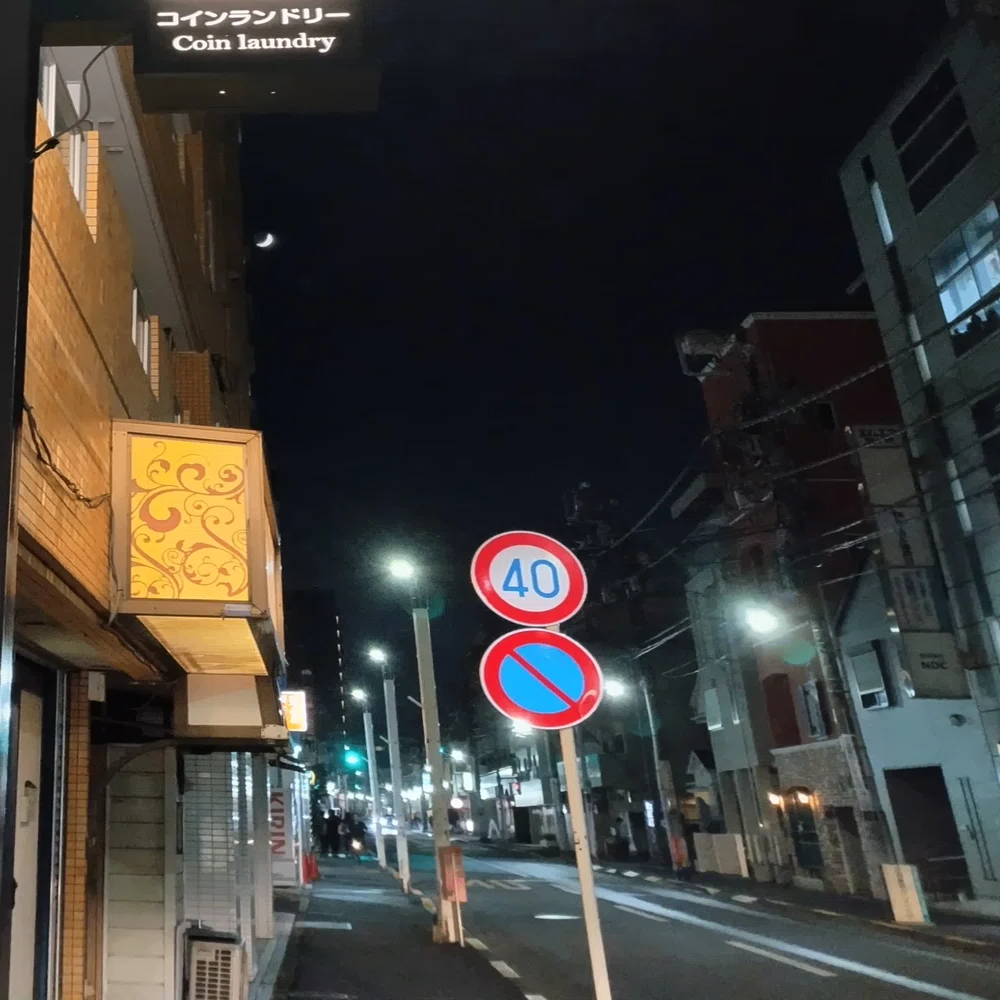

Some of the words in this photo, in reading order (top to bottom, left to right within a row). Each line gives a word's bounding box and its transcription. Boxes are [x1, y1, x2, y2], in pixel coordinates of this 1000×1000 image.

[156, 7, 351, 27] コインランドリー
[172, 34, 231, 51] Coin
[237, 32, 336, 53] laundry
[502, 558, 560, 599] 40
[270, 791, 286, 855] KIRIN
